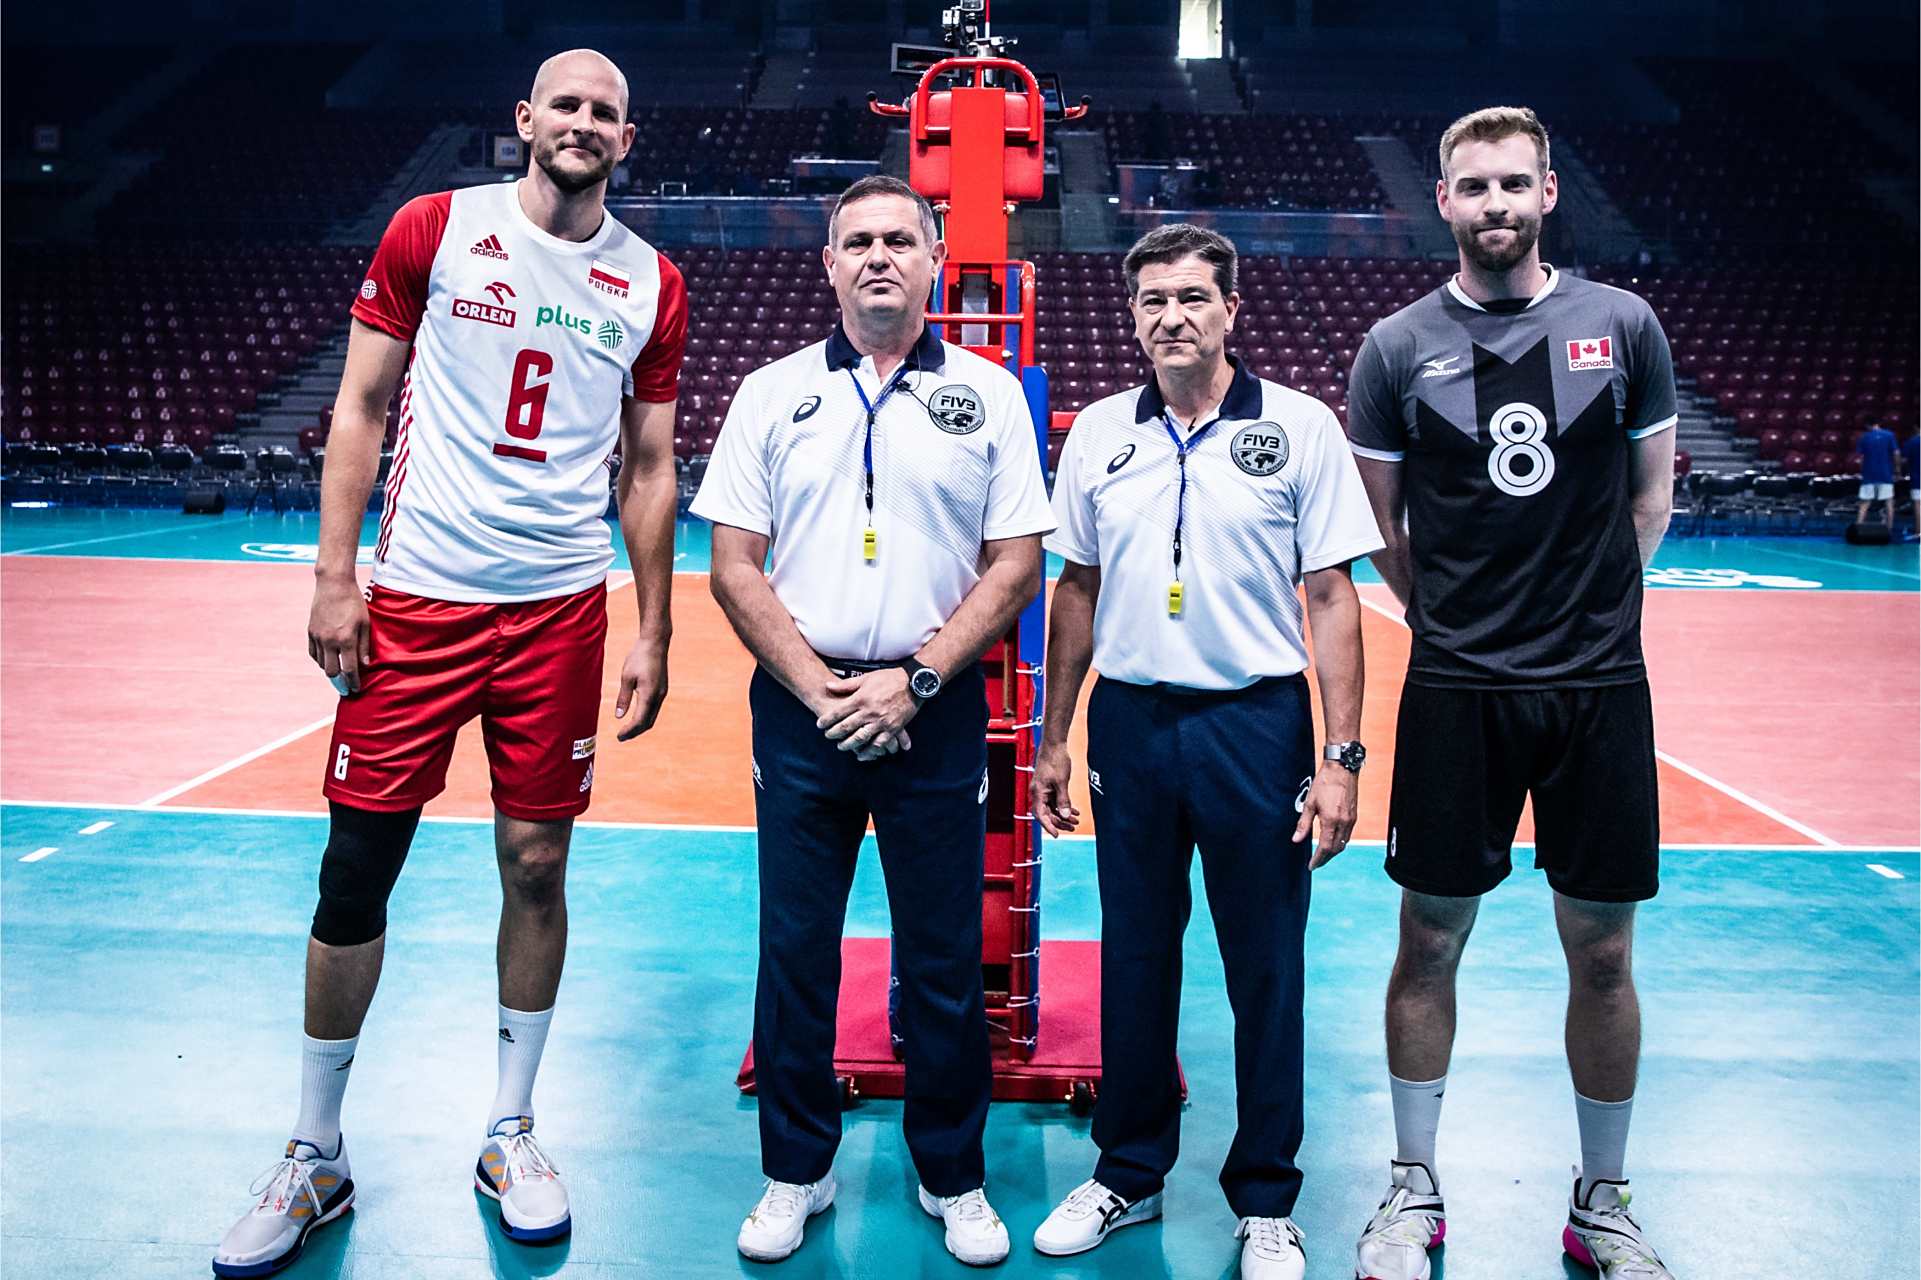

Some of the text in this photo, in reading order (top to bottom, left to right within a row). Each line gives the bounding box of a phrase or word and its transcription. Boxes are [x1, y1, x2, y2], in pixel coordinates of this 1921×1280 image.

[470, 246, 509, 261] adidas
[588, 277, 629, 299] POLSKA
[455, 302, 513, 325] ORLEN
[536, 304, 592, 334] plus
[1570, 359, 1612, 369] Canada
[505, 348, 554, 440] 6
[940, 394, 976, 411] FIVB
[1243, 433, 1280, 449] FIVB
[1487, 402, 1556, 497] 8
[334, 743, 351, 781] 6
